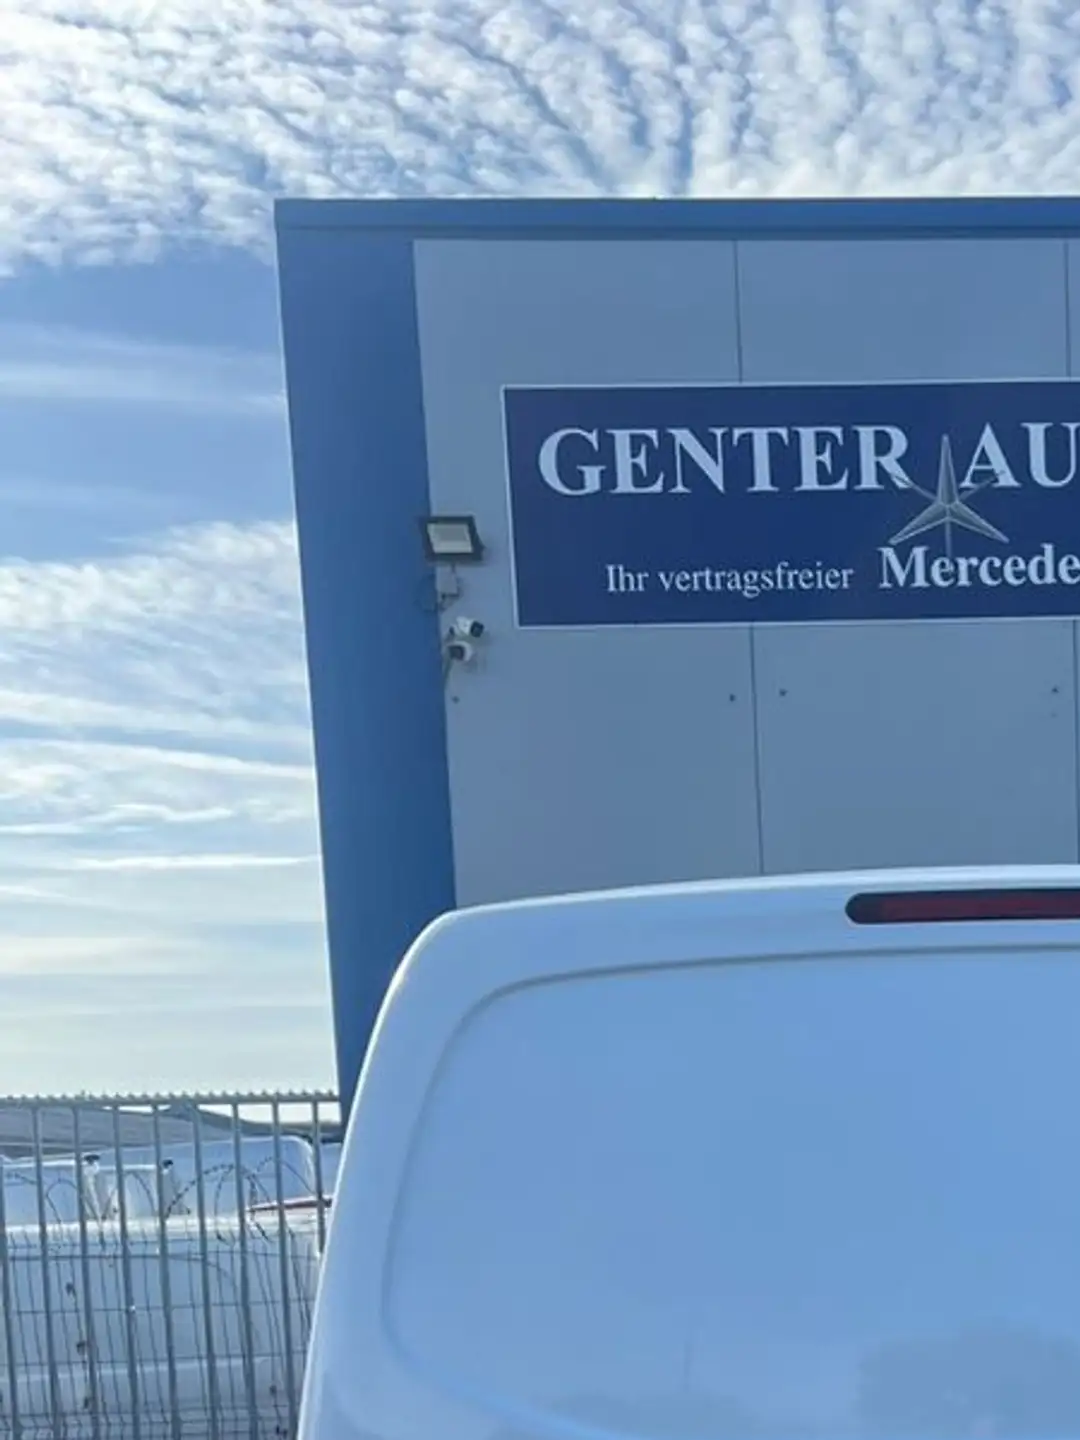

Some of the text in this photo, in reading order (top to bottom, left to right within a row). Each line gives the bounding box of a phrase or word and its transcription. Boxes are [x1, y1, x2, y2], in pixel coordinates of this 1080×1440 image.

[538, 425, 911, 496] GENTER
[606, 563, 649, 593] Ihr
[658, 561, 854, 598] vertragsfreier
